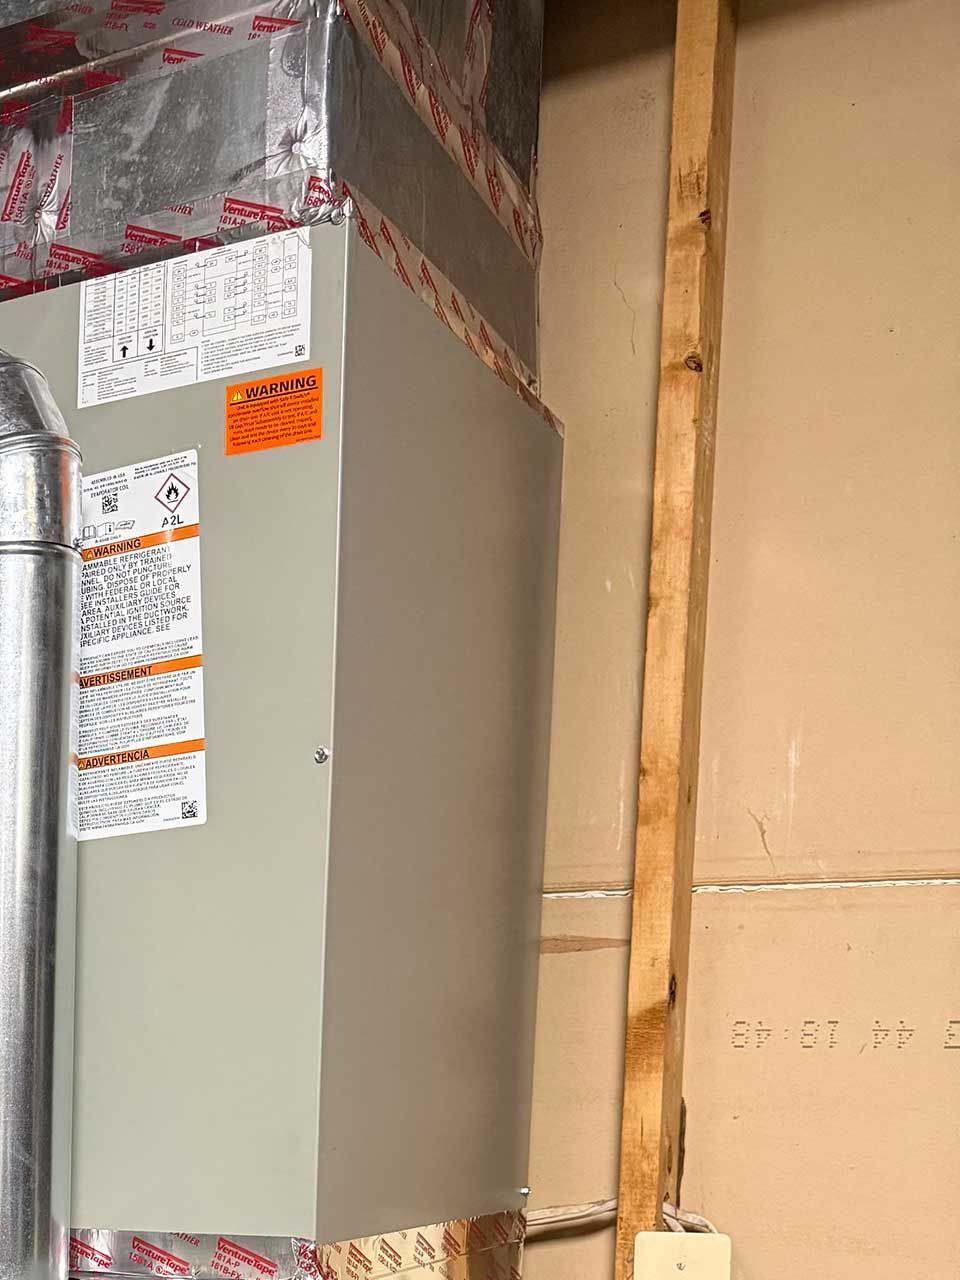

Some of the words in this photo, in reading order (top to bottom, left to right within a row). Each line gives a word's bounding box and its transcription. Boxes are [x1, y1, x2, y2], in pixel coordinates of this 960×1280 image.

[172, 17, 194, 29] COLD
[196, 21, 234, 35] WEATHER
[3, 149, 33, 222] VentureTape
[245, 375, 317, 399] WARNING
[162, 514, 184, 528] A2L
[82, 557, 118, 572] AMMABLE
[120, 546, 170, 563] REFRIGERANT
[94, 539, 141, 557] WARNING
[81, 567, 106, 578] PAIRED
[107, 563, 126, 573] ONLY
[128, 561, 138, 569] BY
[140, 553, 172, 567] TRAINED
[81, 577, 102, 587] NNEL.
[103, 574, 114, 583] DO
[116, 570, 131, 580] NOT
[133, 562, 173, 575] PUNCTURE
[81, 584, 105, 595] UBING.
[106, 576, 138, 589] DISPOSE
[140, 573, 150, 582] OF
[152, 564, 191, 580] PROPERLY
[85, 591, 103, 601] WITH
[105, 585, 139, 597] FEDERAL
[152, 576, 178, 587] LOCAL
[95, 592, 138, 607] INSTALLERS
[140, 586, 162, 597] GUIDE
[164, 583, 180, 592] FOR
[105, 598, 142, 612] AUXILIARY
[144, 591, 176, 603] DEVICES
[80, 619, 117, 633] NSTALLED
[128, 613, 143, 622] THE
[144, 605, 189, 619] DUCTWORK.
[85, 610, 125, 623] POTENTIAL
[127, 603, 159, 615] IGNITION
[160, 595, 191, 608] SOURCE
[80, 628, 110, 640] UXILIARY
[112, 621, 143, 633] DEVICES
[145, 616, 170, 626] LISTED
[172, 612, 188, 620] FOR
[156, 623, 170, 633] SEE
[80, 666, 152, 688] AVERTISSEMENT
[85, 750, 149, 768] ADVERTENCIA
[70, 1243, 112, 1269] tureTape
[132, 1241, 189, 1275] VentureTape
[213, 1252, 240, 1267] 181A-P
[217, 1241, 277, 1276] VentureTape
[210, 1261, 242, 1280] 181B-FX
